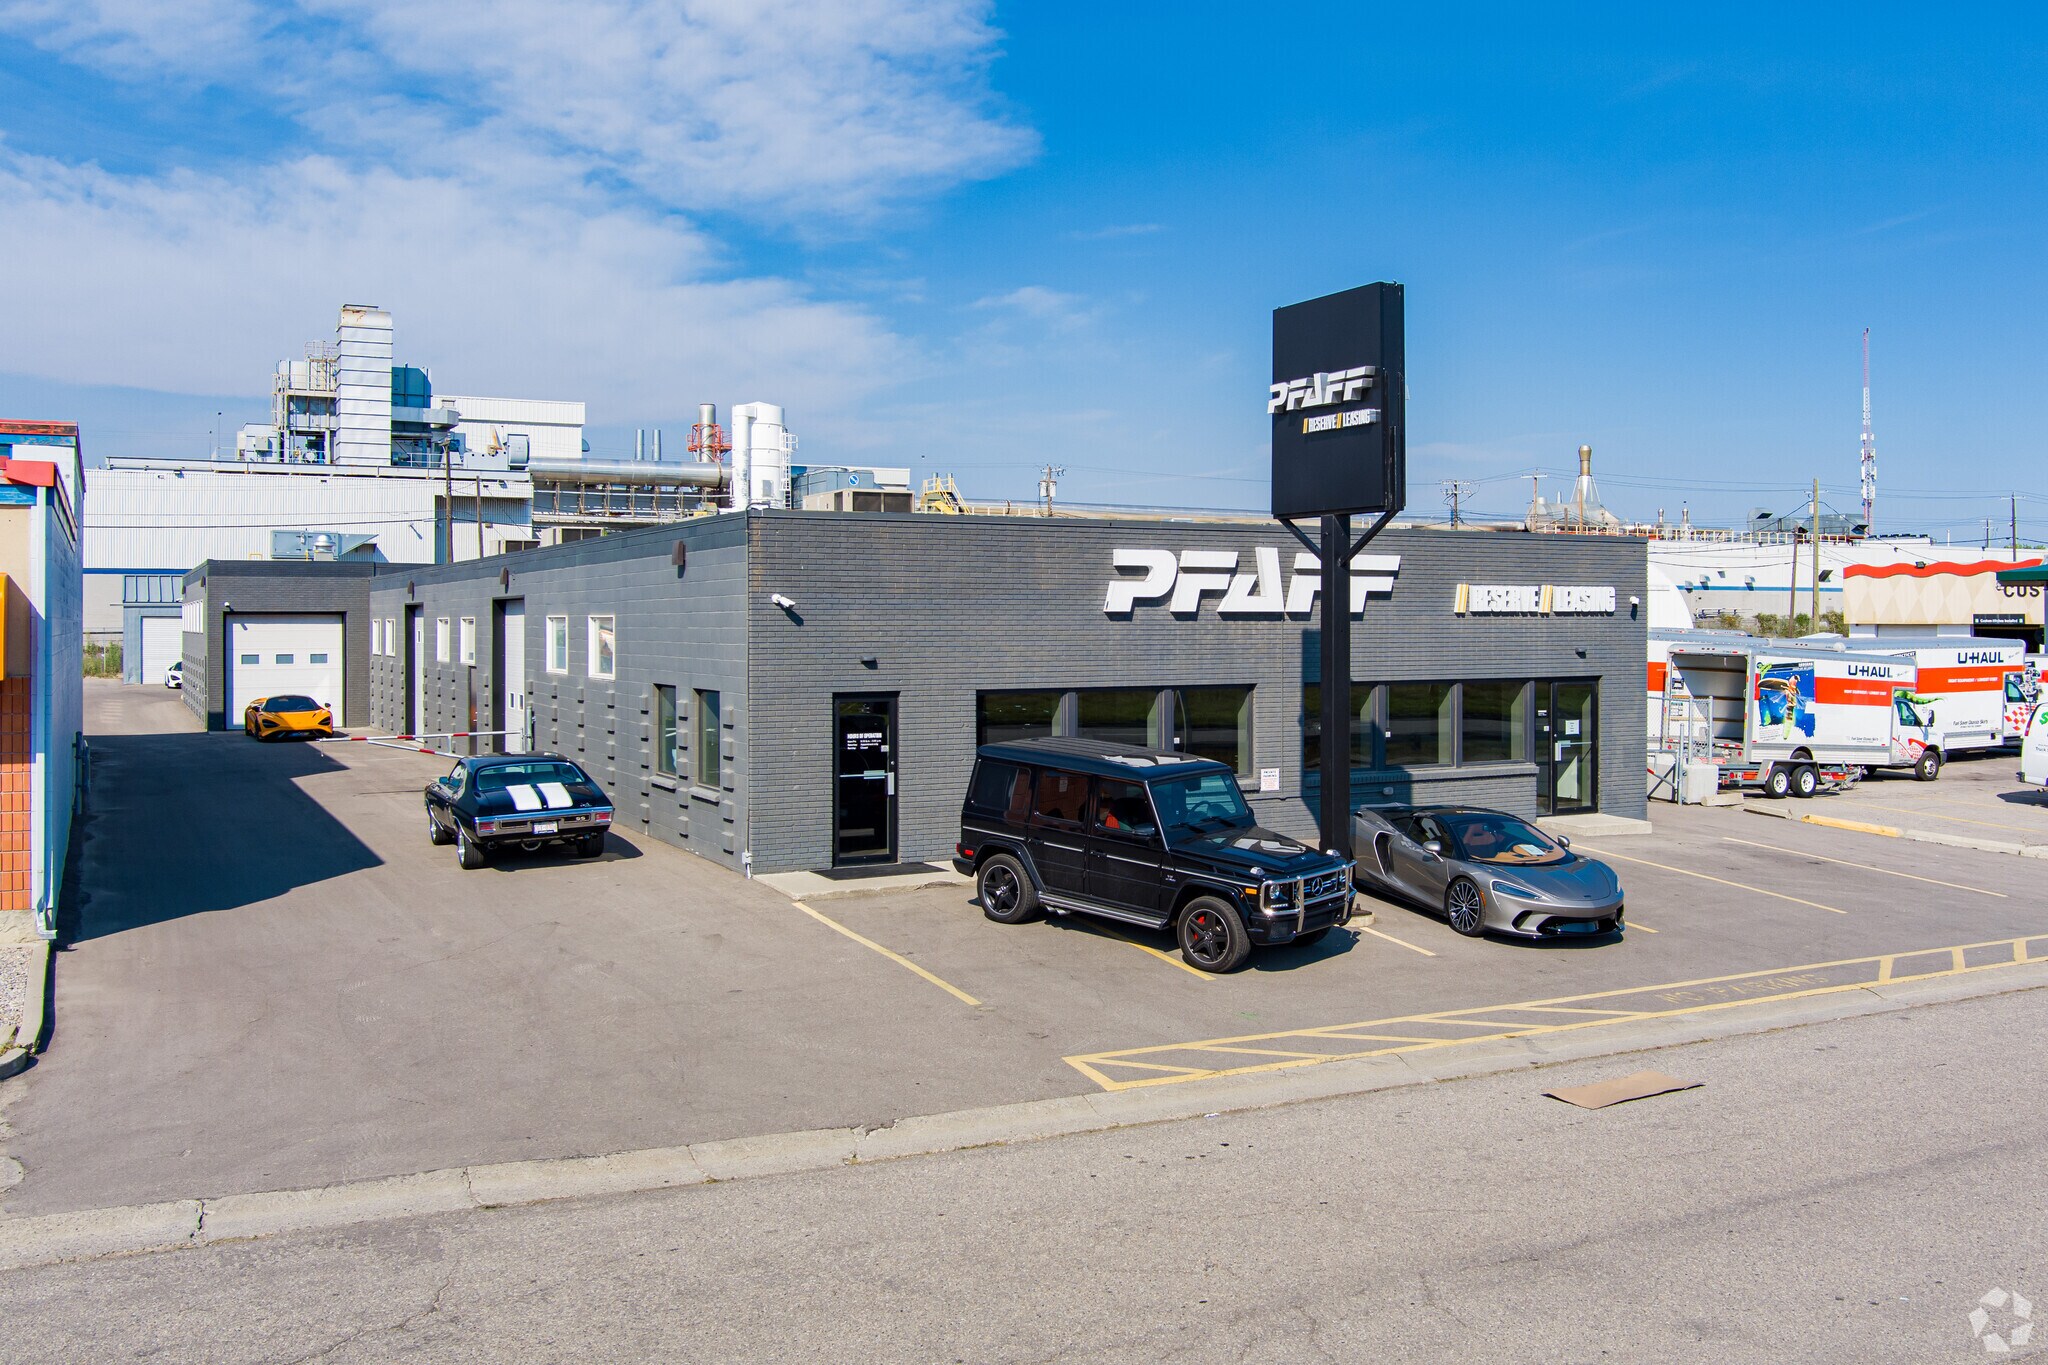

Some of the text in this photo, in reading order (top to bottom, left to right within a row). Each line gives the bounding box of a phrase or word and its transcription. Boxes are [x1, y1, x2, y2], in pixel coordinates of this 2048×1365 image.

[1267, 366, 1375, 413] PFAFF
[1342, 408, 1371, 427] LEASING
[1103, 547, 1401, 614] PFAFF
[1553, 586, 1616, 612] LEASING
[1957, 652, 2004, 664] U-HAUL
[1848, 665, 1893, 678] U-HAUL
